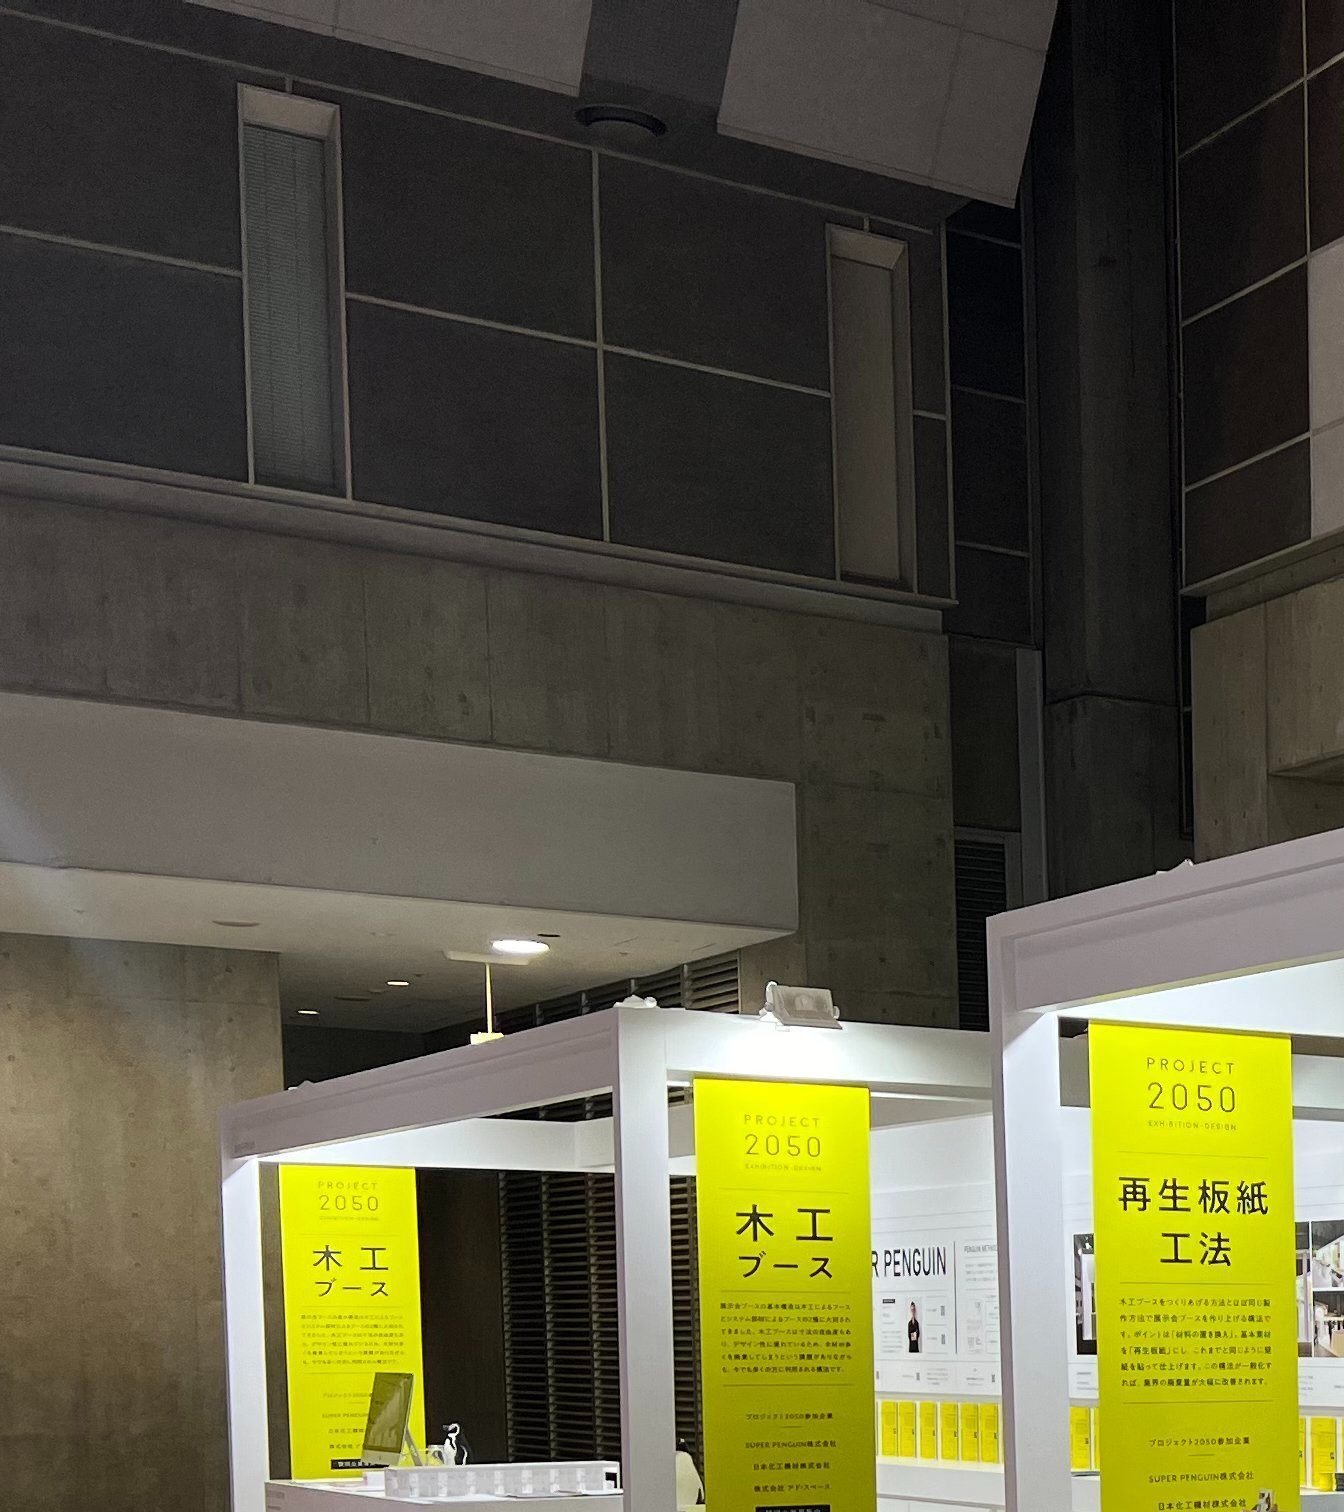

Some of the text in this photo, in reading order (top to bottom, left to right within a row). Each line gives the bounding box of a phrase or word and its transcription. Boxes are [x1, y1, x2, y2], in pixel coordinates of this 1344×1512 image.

[1146, 1057, 1235, 1074] PROJECT
[1147, 1082, 1236, 1113] 2050
[744, 1114, 820, 1128] PROJECT
[744, 1133, 821, 1158] 2050
[318, 1181, 378, 1191] PROJECT
[1118, 1176, 1268, 1215] 再生板紙
[319, 1194, 379, 1211] 2050
[735, 1204, 833, 1242] 木工
[312, 1244, 389, 1271] 木工
[884, 1246, 947, 1278] PENGUIN
[1160, 1232, 1232, 1267] 工法
[738, 1250, 833, 1279] ブース
[314, 1277, 389, 1297] ブース
[1148, 1474, 1177, 1483] SUPER
[1158, 1499, 1246, 1511] 日本化工機材株式会社
